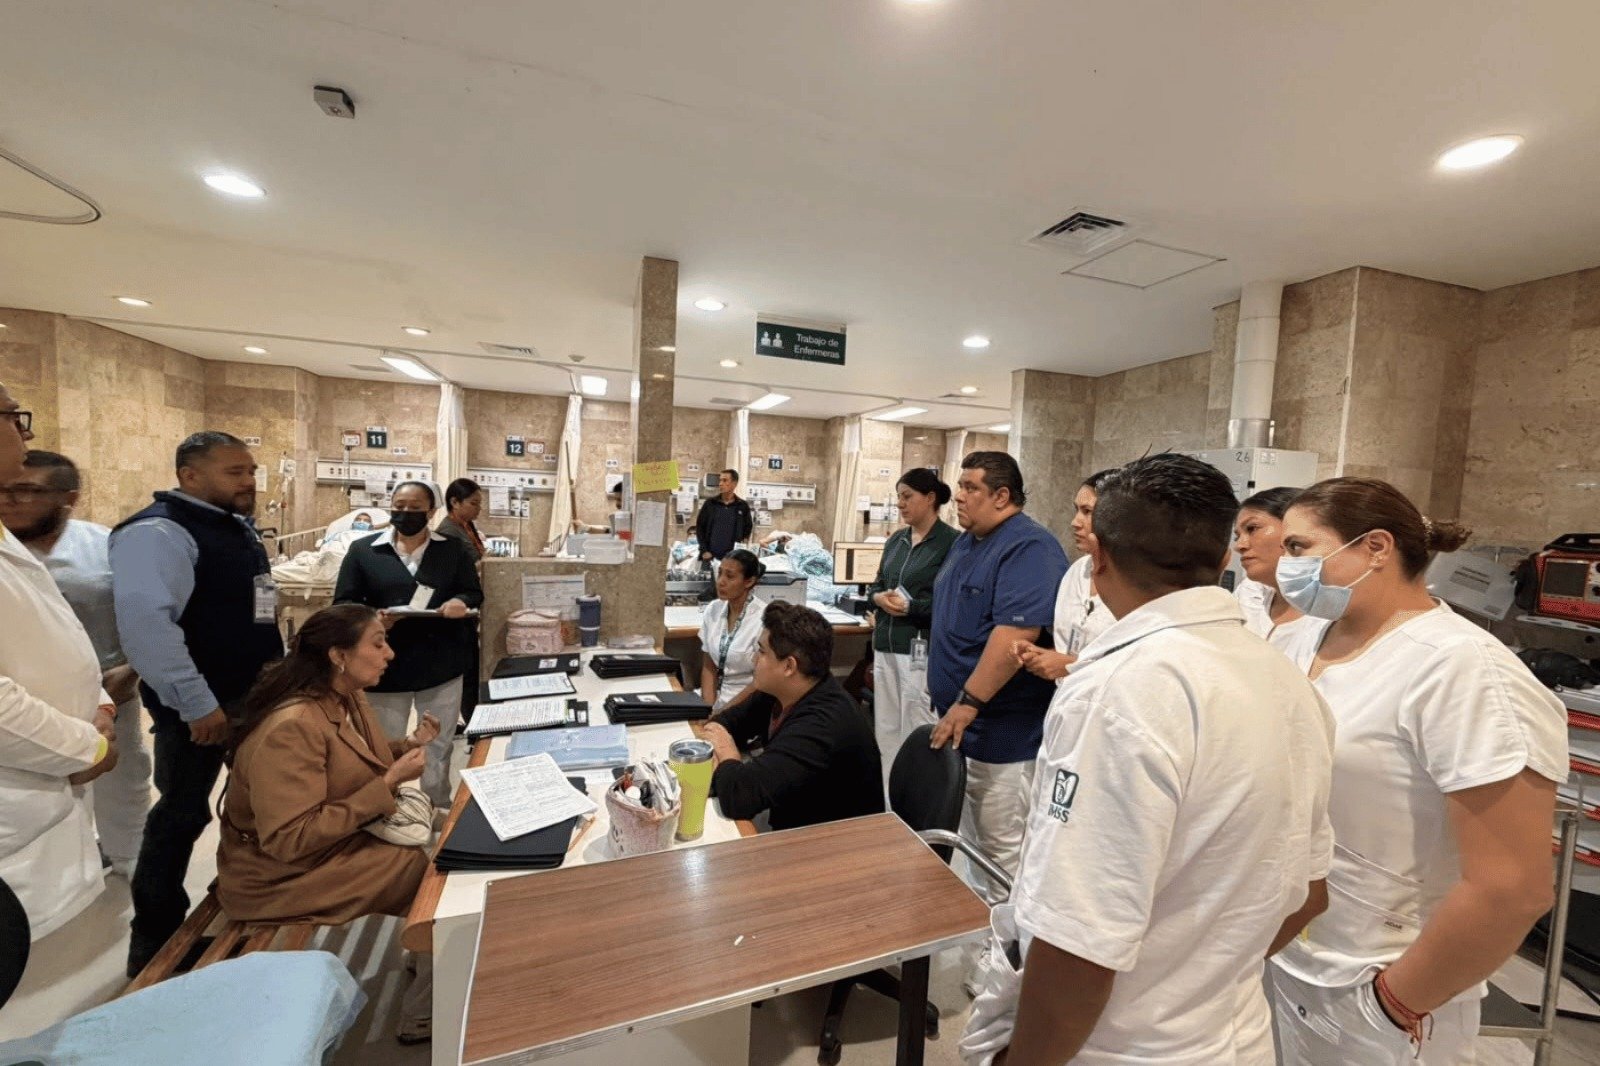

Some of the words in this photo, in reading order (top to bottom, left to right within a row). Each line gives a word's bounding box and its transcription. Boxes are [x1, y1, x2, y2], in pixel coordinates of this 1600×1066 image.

[796, 333, 826, 346] Trabajo
[828, 338, 839, 347] de
[793, 344, 840, 359] Enfermeras
[370, 435, 383, 445] 11
[509, 443, 522, 454] 12
[1235, 451, 1249, 462] 26
